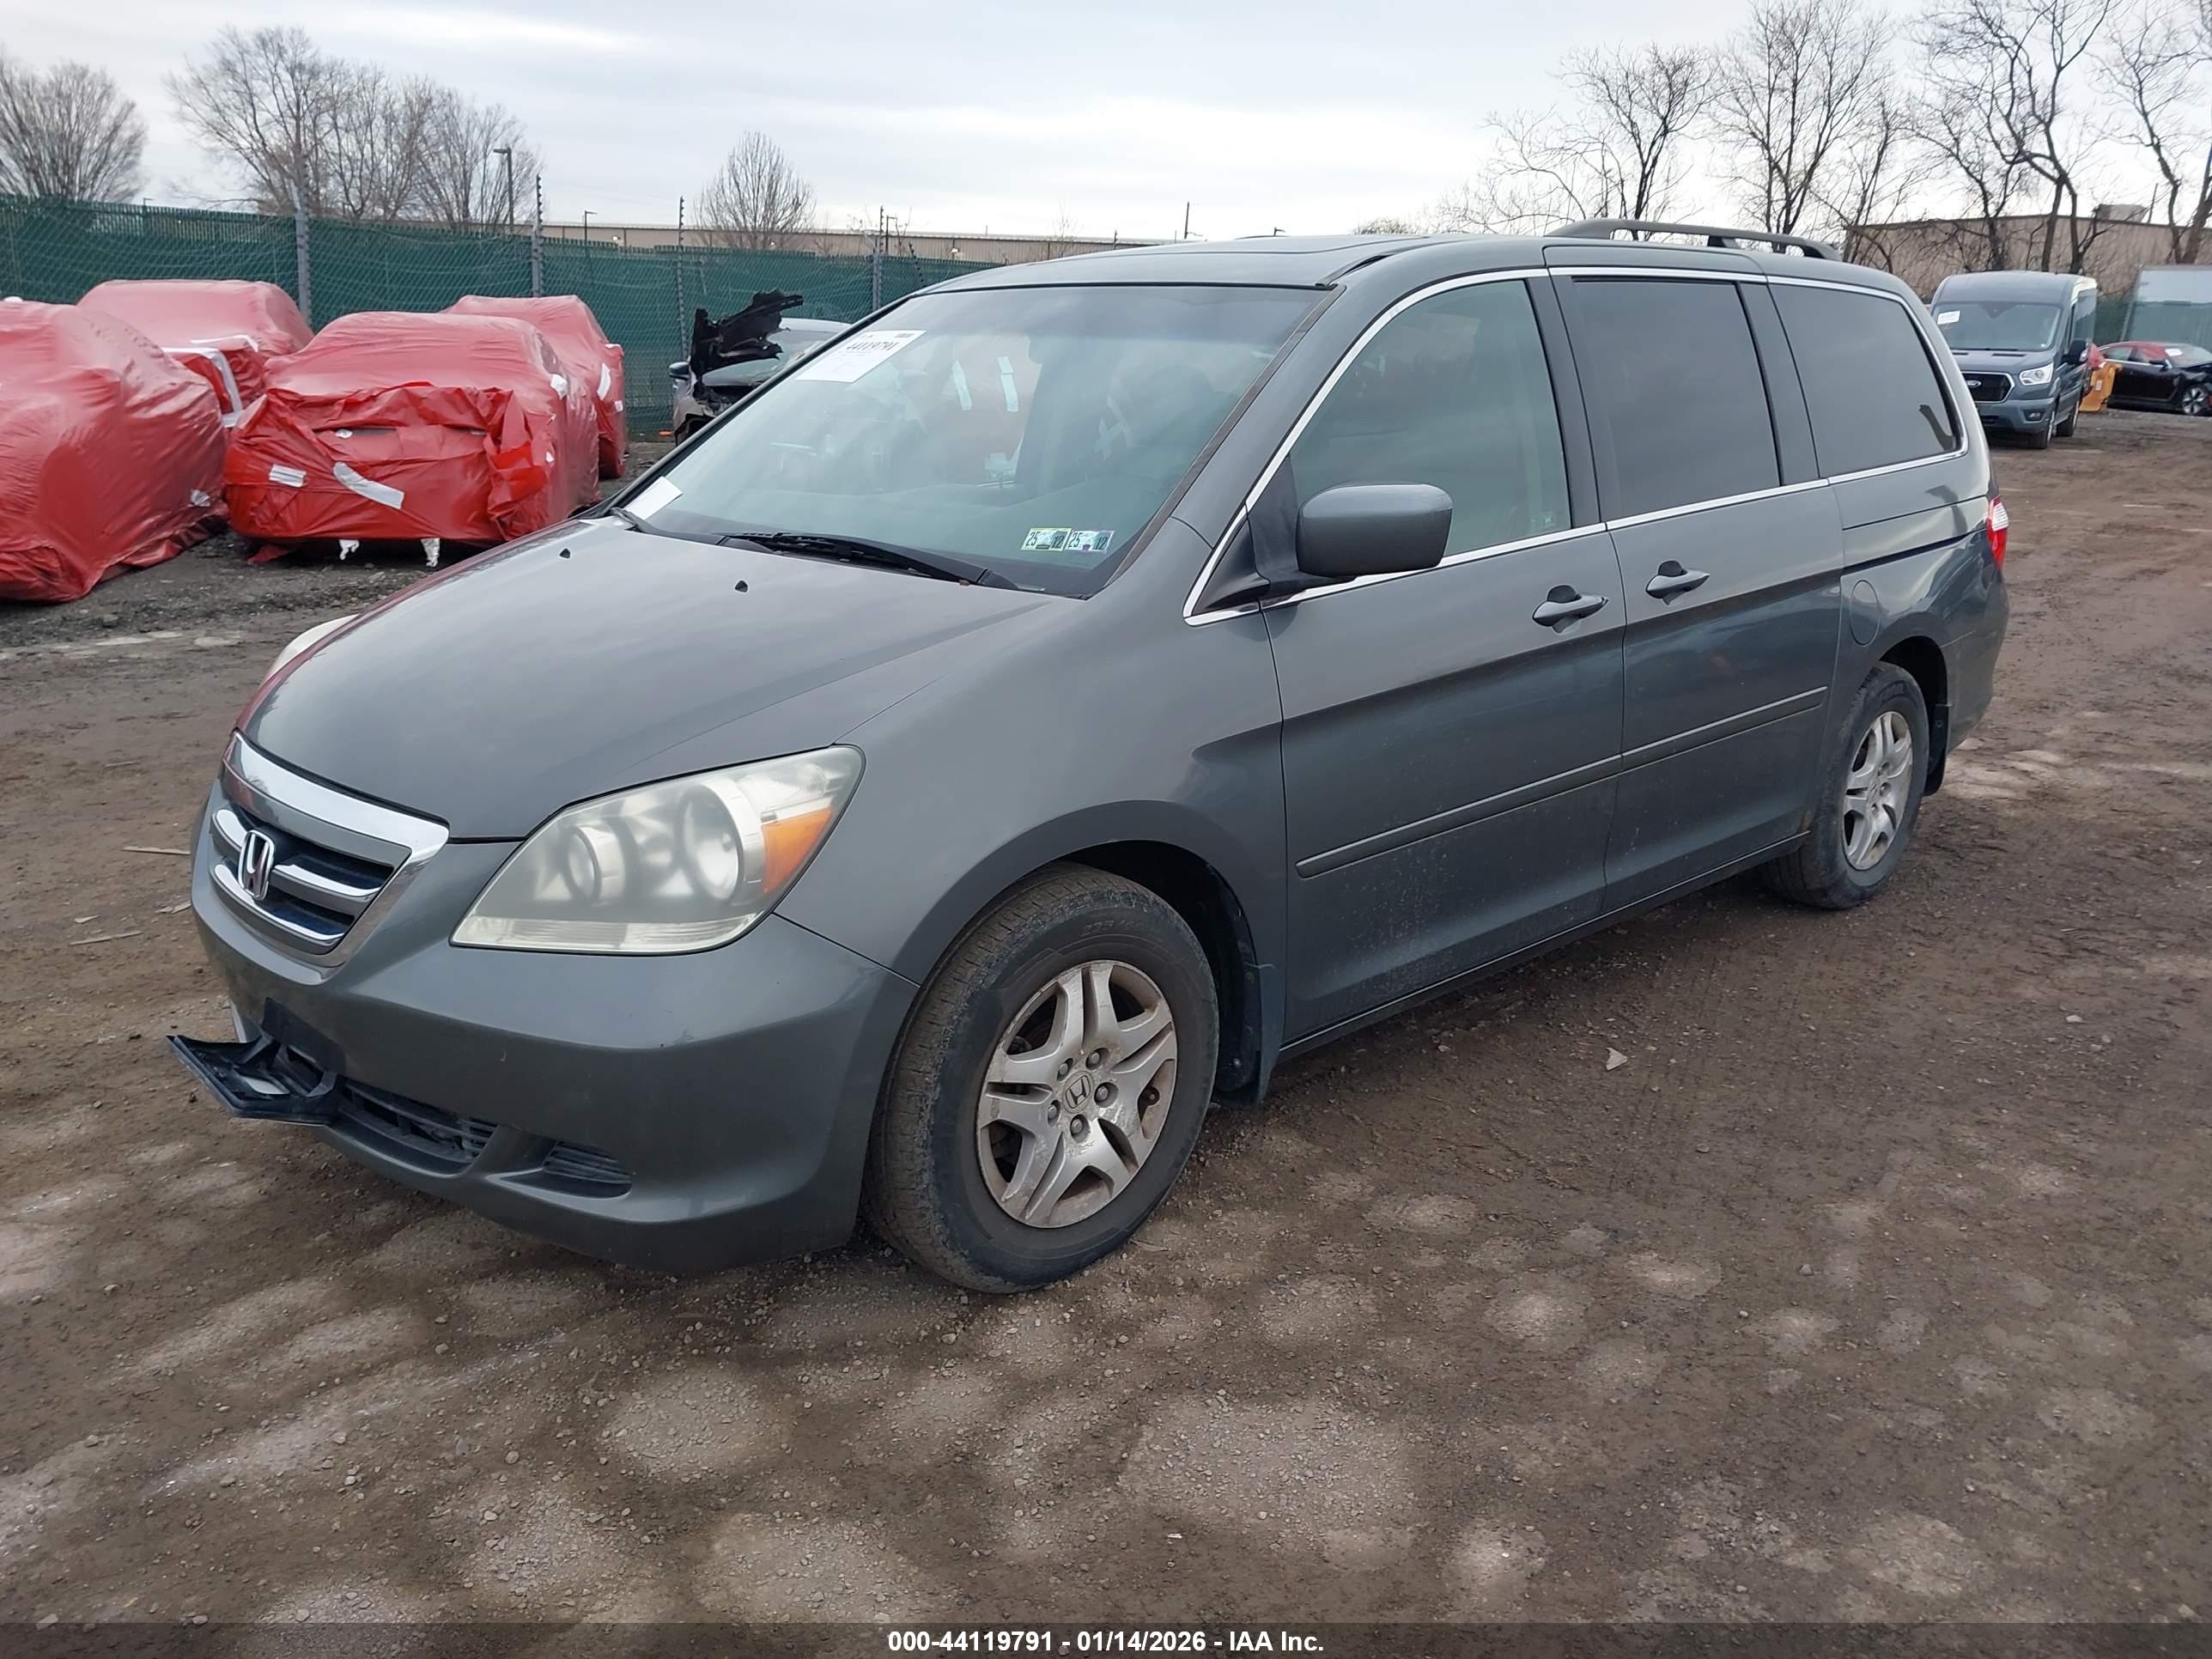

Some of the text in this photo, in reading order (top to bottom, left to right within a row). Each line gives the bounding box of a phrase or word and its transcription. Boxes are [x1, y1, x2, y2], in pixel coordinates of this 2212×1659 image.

[1025, 531, 1040, 547] 25
[1051, 535, 1066, 550] 12
[1068, 532, 1083, 548] 25
[1095, 536, 1109, 550] 12
